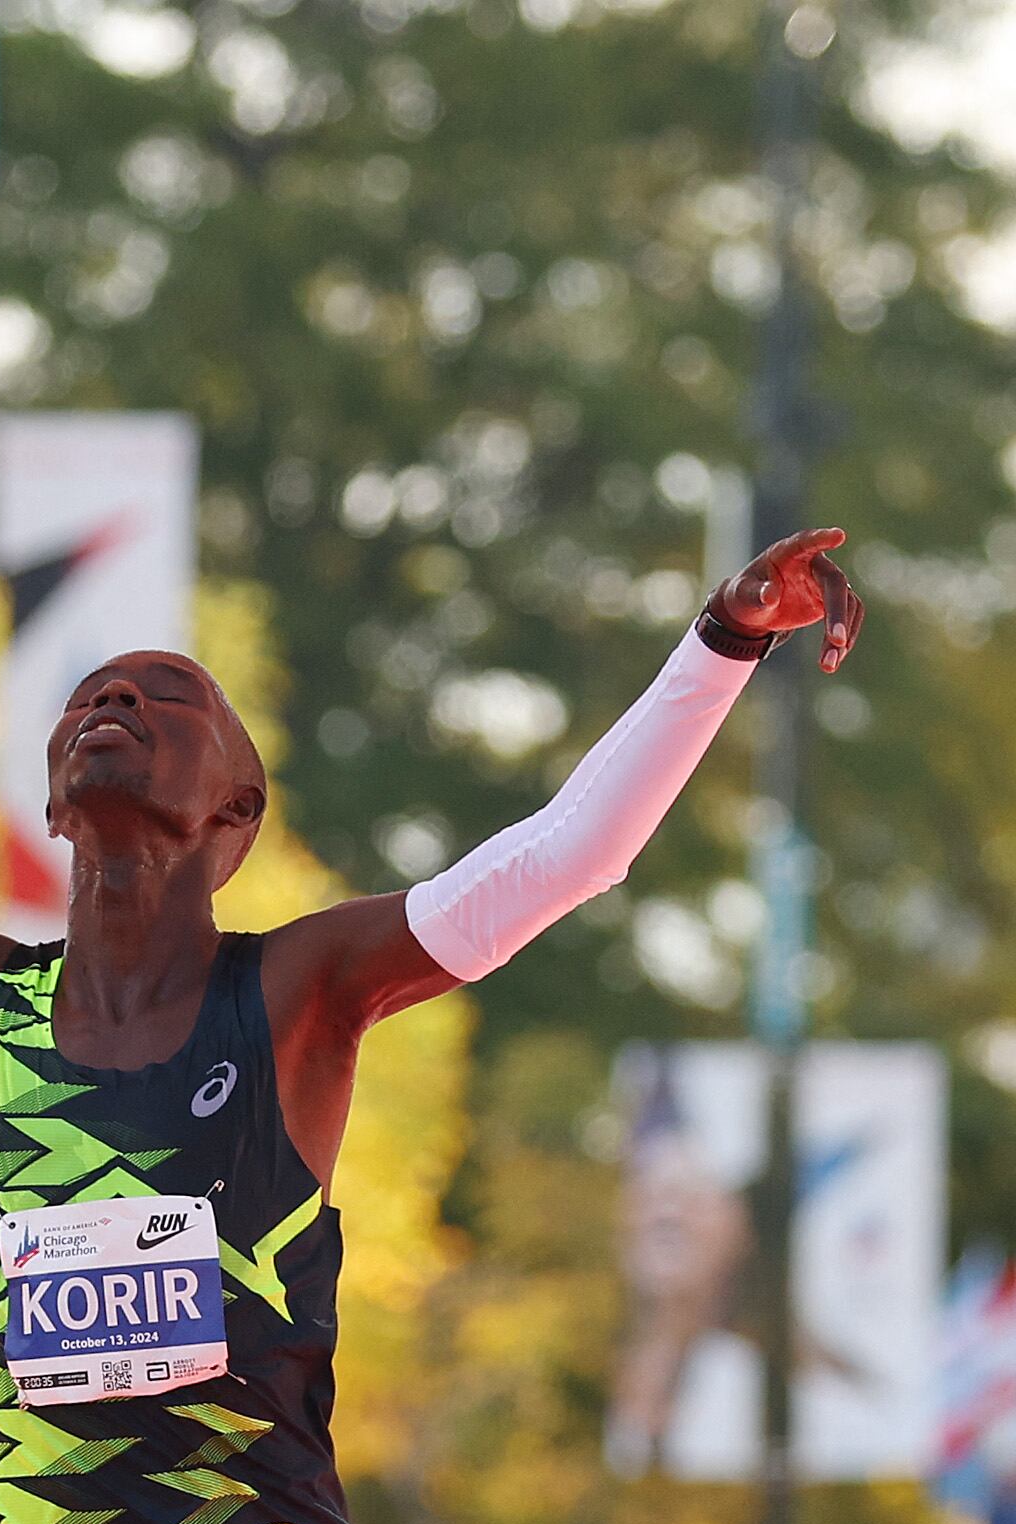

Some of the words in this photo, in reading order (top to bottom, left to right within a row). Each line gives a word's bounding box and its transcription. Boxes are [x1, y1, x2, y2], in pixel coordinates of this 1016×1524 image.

[146, 1213, 188, 1233] RUN
[43, 1234, 87, 1247] Chicago
[43, 1244, 97, 1259] Marathon
[21, 1268, 202, 1335] KORIR
[61, 1338, 106, 1350] October
[109, 1334, 128, 1347] 13,
[130, 1331, 160, 1344] 2024
